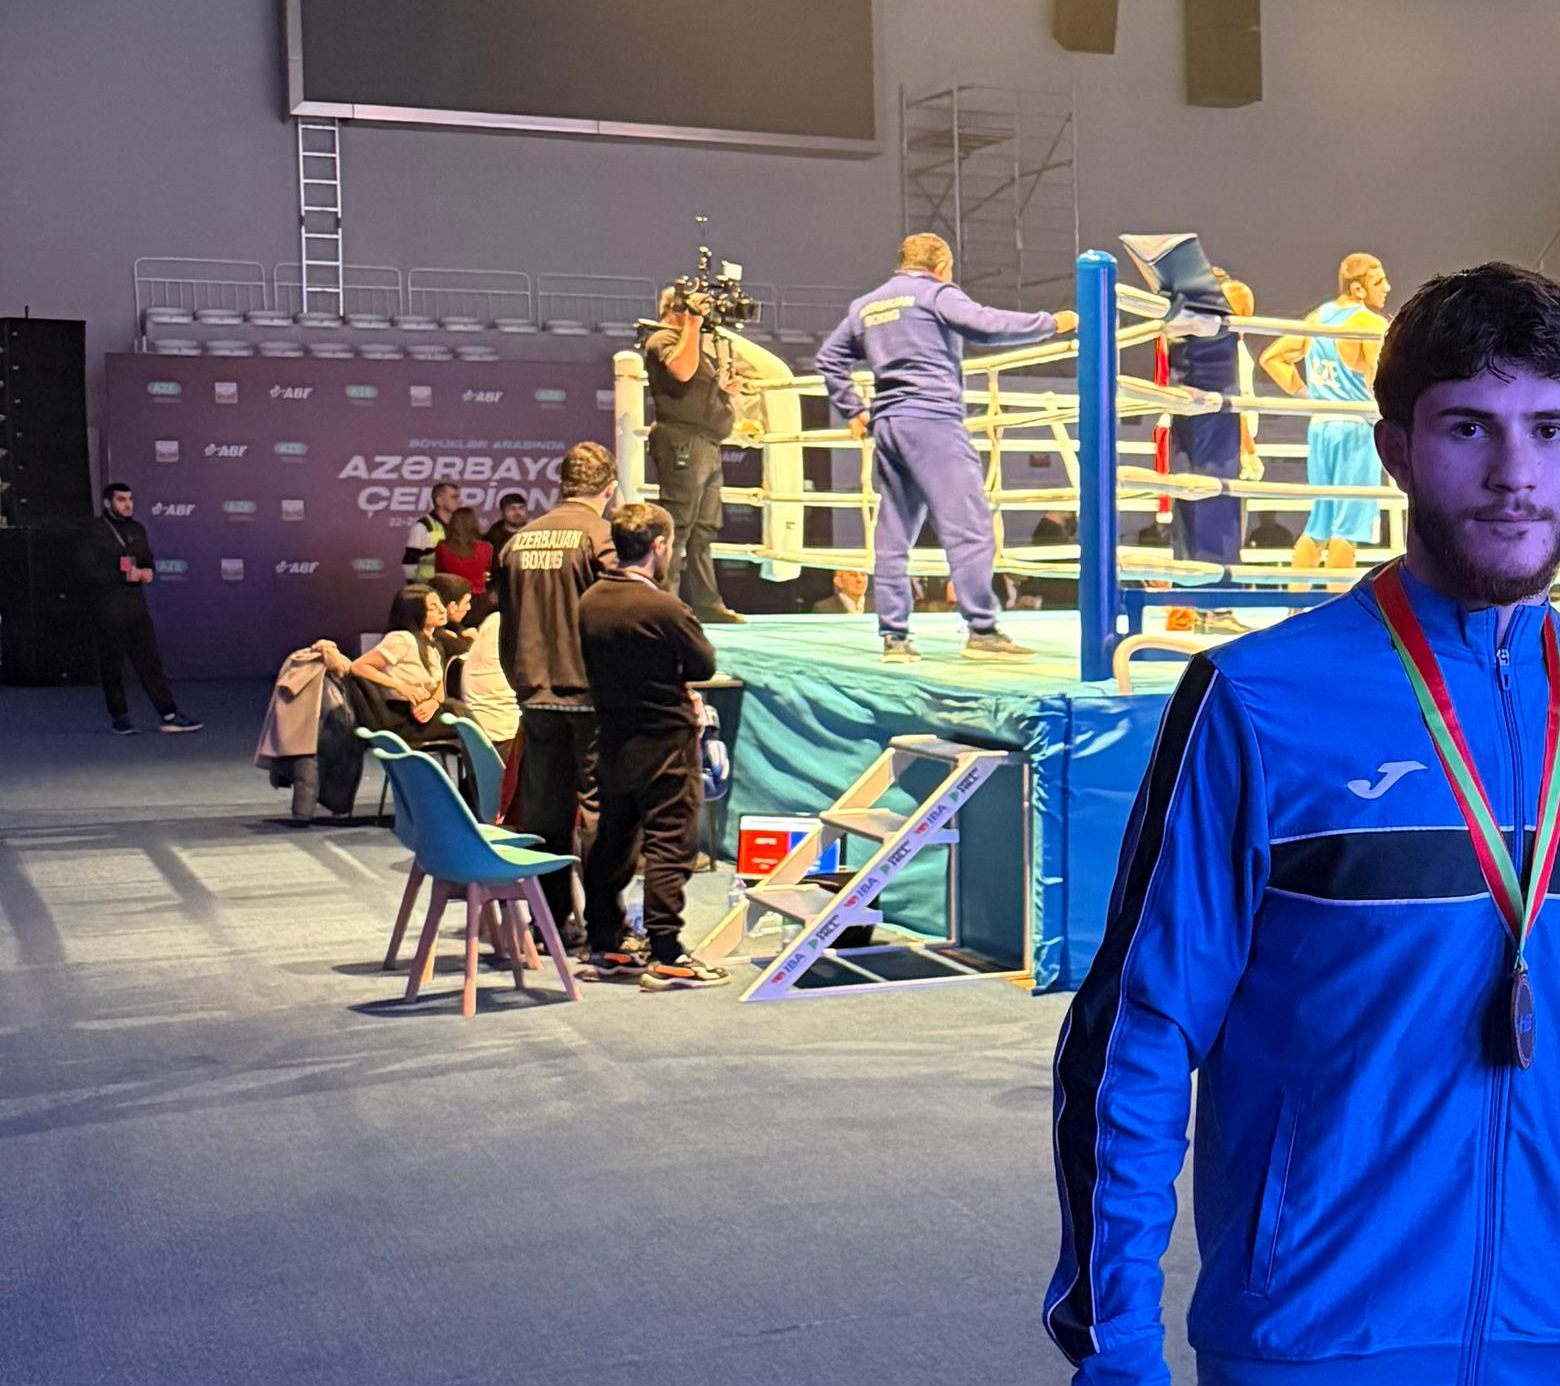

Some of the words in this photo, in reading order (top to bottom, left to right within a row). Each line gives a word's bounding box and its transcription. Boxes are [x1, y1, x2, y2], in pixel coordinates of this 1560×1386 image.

[338, 455, 561, 481] AZƏRBAYC
[926, 803, 950, 827] IBA
[856, 877, 879, 900] IBA
[783, 951, 807, 974] IBA
